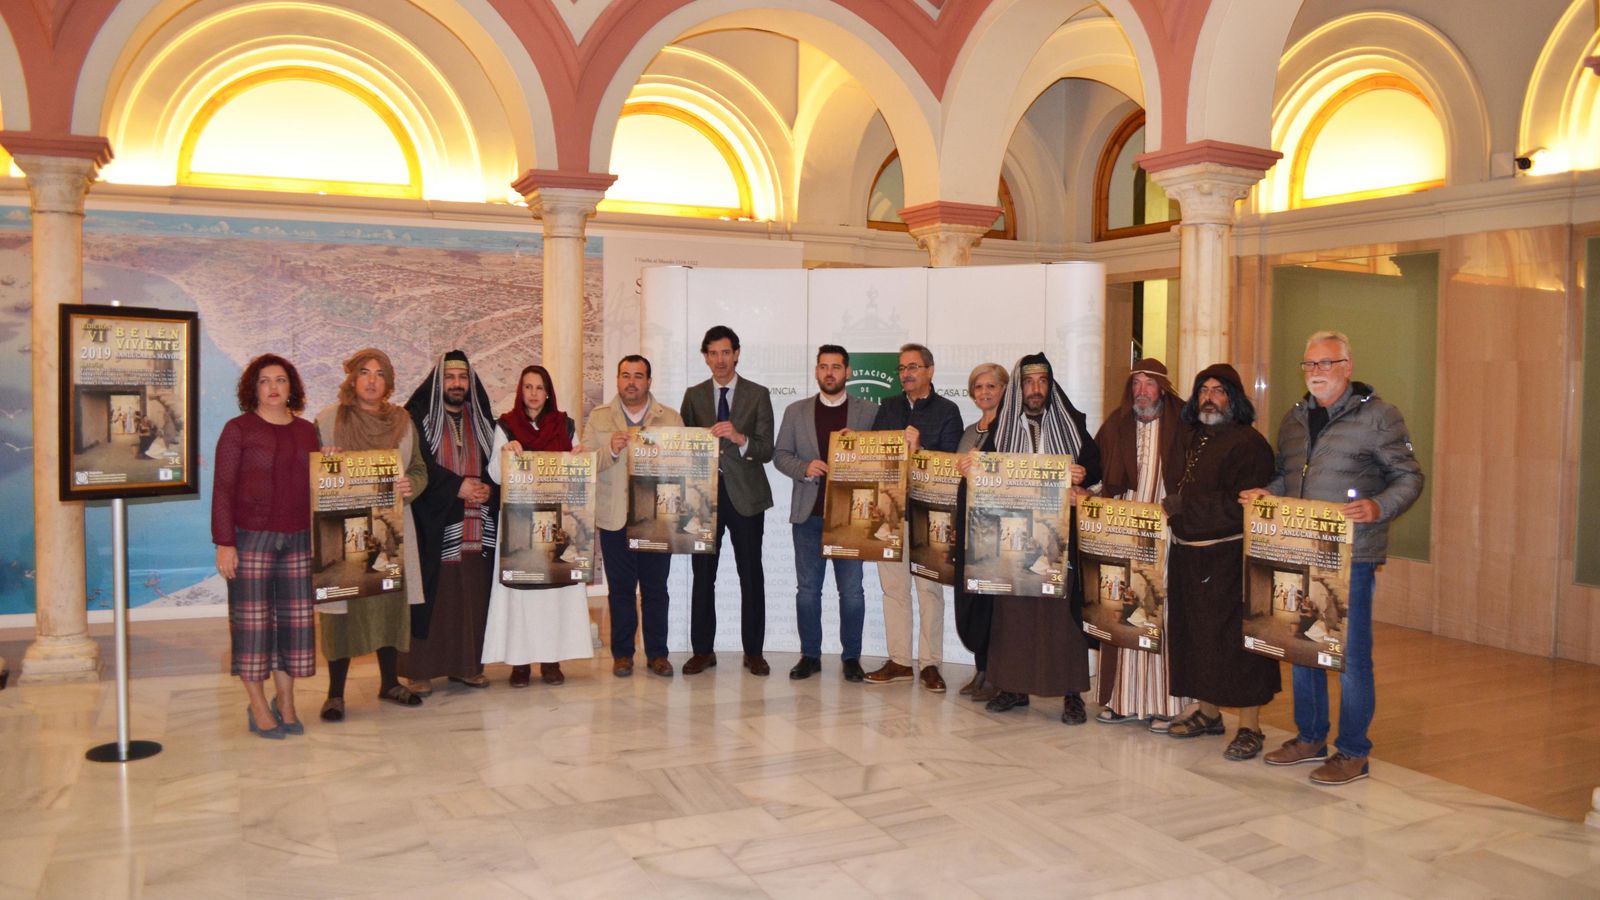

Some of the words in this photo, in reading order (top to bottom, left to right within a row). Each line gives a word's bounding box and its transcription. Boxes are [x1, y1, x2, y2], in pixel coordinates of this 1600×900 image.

[88, 330, 104, 342] VI
[116, 338, 179, 351] VIVIENTE
[80, 346, 112, 360] 2019
[853, 369, 893, 382] UTACION
[769, 387, 797, 395] VINCIA
[937, 389, 960, 397] CASA
[663, 440, 713, 450] VIVIENTE
[840, 441, 852, 450] VI
[859, 445, 905, 454] VIVIENTE
[634, 447, 658, 457] 2019
[834, 453, 856, 462] 2019
[324, 462, 338, 472] VI
[514, 461, 529, 470] VI
[982, 462, 996, 472] VI
[347, 466, 399, 477] VIVIENTE
[537, 466, 592, 476] VIVIENTE
[912, 470, 930, 482] 2019
[1007, 470, 1065, 480] VIVIENTE
[319, 476, 345, 489] 2019
[509, 473, 534, 483] 2019
[976, 476, 1001, 487] 2019
[1085, 507, 1097, 517] VI
[1257, 507, 1271, 518] VI
[1080, 520, 1102, 533] 2019
[1106, 516, 1161, 531] VIVIENTE
[1250, 521, 1277, 536] 2019
[1282, 516, 1346, 534] VIVIENTE
[1051, 573, 1063, 582] 3€
[1147, 628, 1160, 636] 3€
[1328, 642, 1341, 652] 3€
